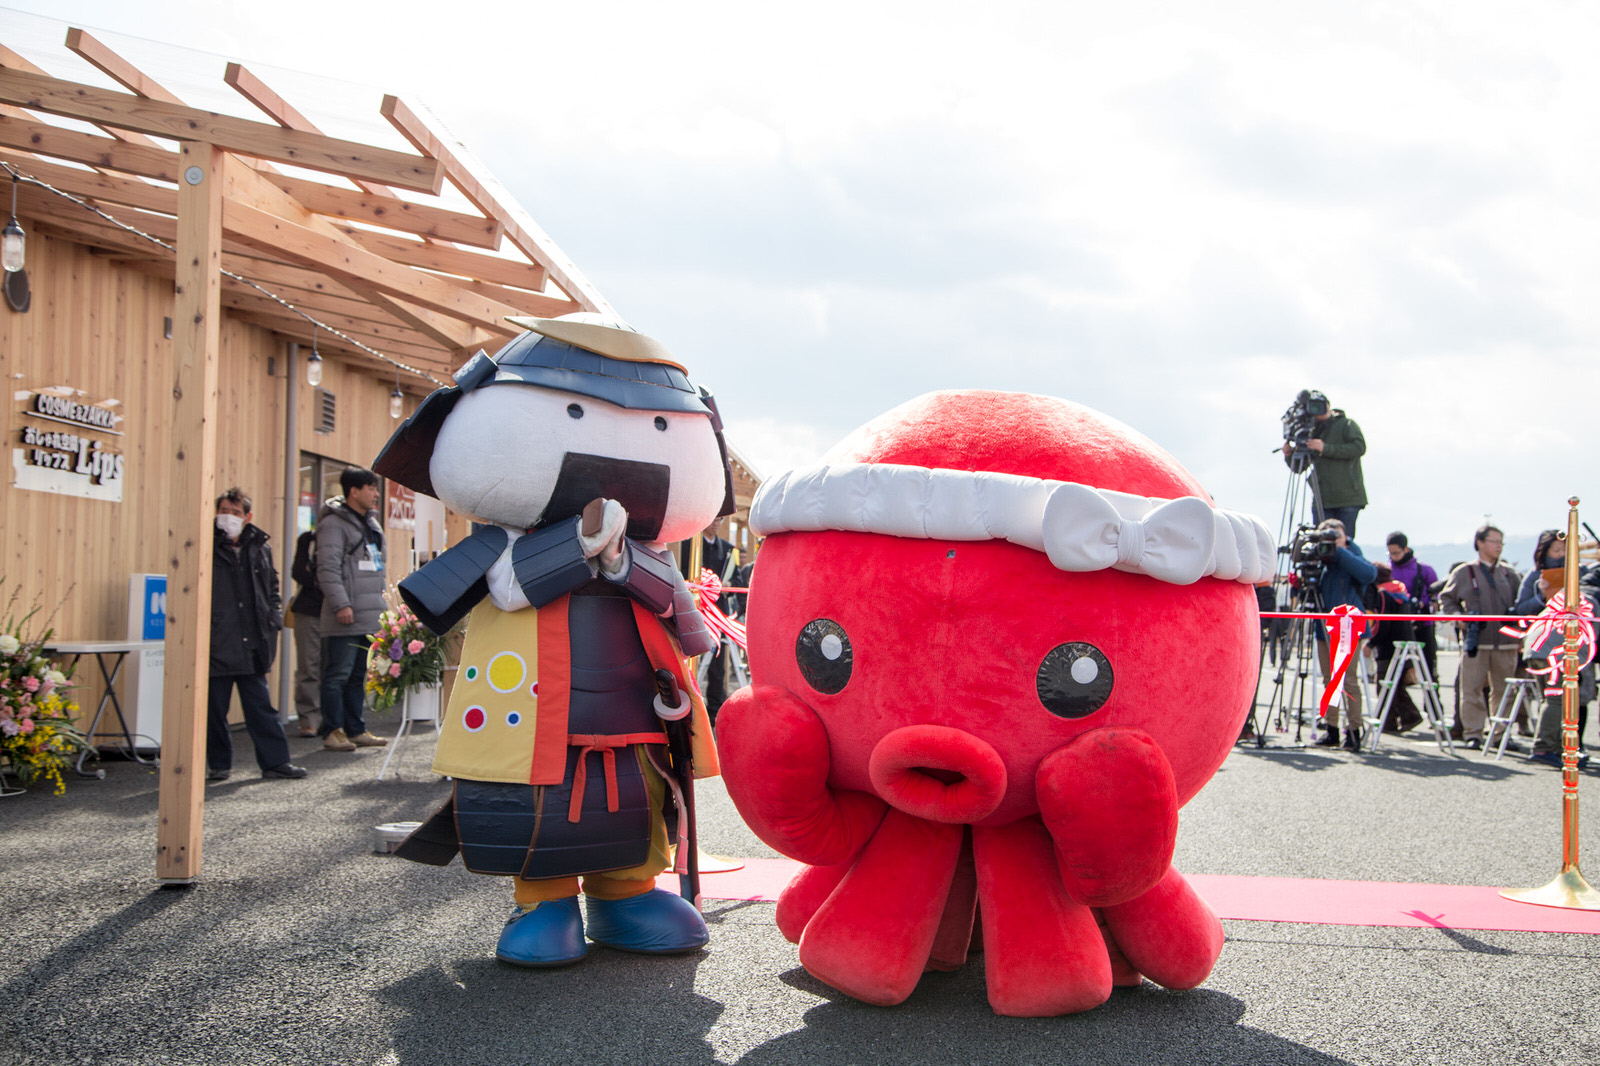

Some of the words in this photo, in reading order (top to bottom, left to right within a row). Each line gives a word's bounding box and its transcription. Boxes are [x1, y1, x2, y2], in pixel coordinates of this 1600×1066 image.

[37, 394, 116, 428] COSME&ZAKKA
[34, 448, 70, 471] リップス
[76, 438, 124, 485] Lips
